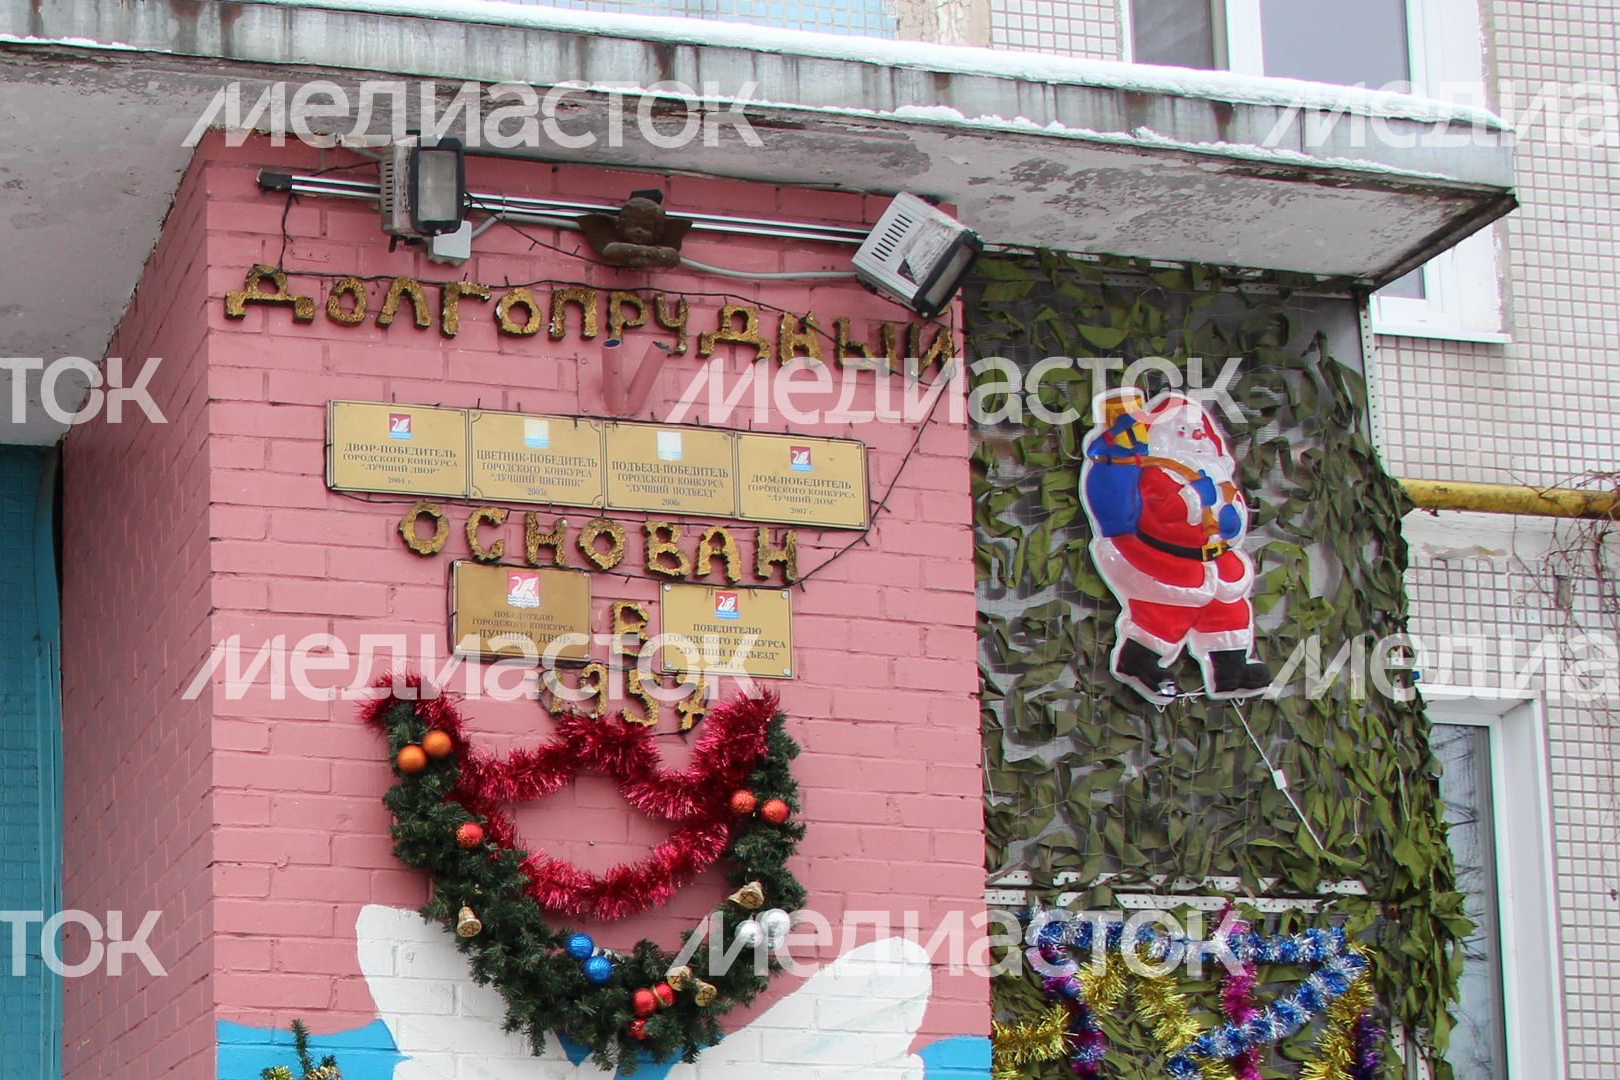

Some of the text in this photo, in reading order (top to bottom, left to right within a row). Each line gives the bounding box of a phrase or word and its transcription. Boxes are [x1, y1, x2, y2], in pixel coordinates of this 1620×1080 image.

[344, 442, 457, 459] ДВОР-ПОБЕДИТЕЛЬ
[476, 449, 598, 468] ЦВЕТНИК-ПОБЕДИТЕЛЬ
[342, 452, 458, 468] ГОРОДСКОГО КОНКУРСА
[482, 462, 593, 479] ГОРОДСКОГО КОНКУРСА
[612, 461, 729, 479] ПОДЪЕЗД-ПОБЕДИТЕЛЬ
[617, 473, 724, 489] ГОРОДСКОГО КОНКУРСА
[751, 474, 852, 490] ДОМ-ПОБЕДИТЕЛЬ
[748, 484, 856, 499] ГОРОДСКОГО КОНКУРСА
[790, 506, 807, 515] 2007
[397, 500, 798, 583] ОСНОВАН
[530, 621, 574, 633] КОНКУРСА
[610, 600, 654, 659] В
[693, 623, 762, 635] ПОБЕДИТЕЛЮ
[668, 634, 787, 649] ГОРОДСКОГО КОНКУРСА
[538, 662, 708, 731] 1957
